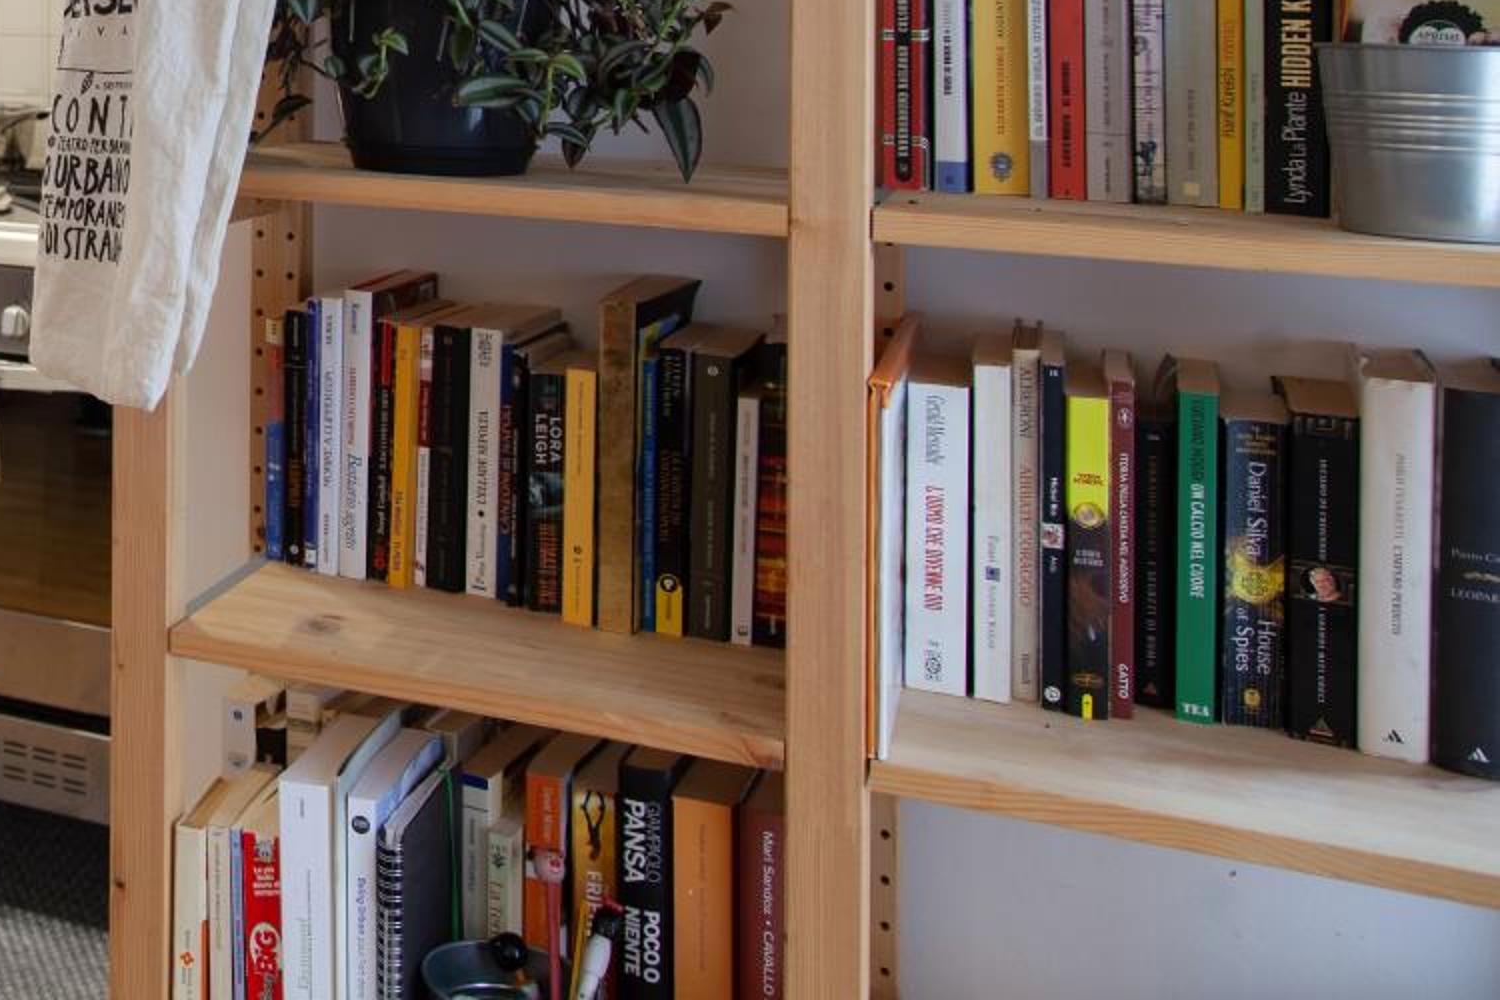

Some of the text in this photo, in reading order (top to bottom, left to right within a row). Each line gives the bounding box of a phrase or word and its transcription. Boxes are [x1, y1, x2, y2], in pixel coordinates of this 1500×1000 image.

[1281, 17, 1311, 88] HIDDEN
[1282, 91, 1304, 142] Plante
[1283, 160, 1311, 204] Lynda
[535, 412, 548, 466] LEIGH
[550, 416, 562, 463] LORA
[1189, 501, 1205, 539] CALCIO
[1247, 461, 1268, 557] Daniel Silva
[1189, 541, 1205, 561] NEL
[1189, 562, 1205, 600] CUORE
[1229, 625, 1255, 673] Spies
[1256, 619, 1277, 676] House
[1117, 663, 1129, 700] GATTO
[1182, 702, 1210, 718] TEA
[624, 797, 646, 883] PANSA
[646, 801, 662, 883] GIAMPAOLO
[762, 864, 775, 915] Sandoz
[624, 904, 641, 977] NIENTE
[643, 909, 661, 984] POCO O
[763, 930, 777, 995] CAVALLO
